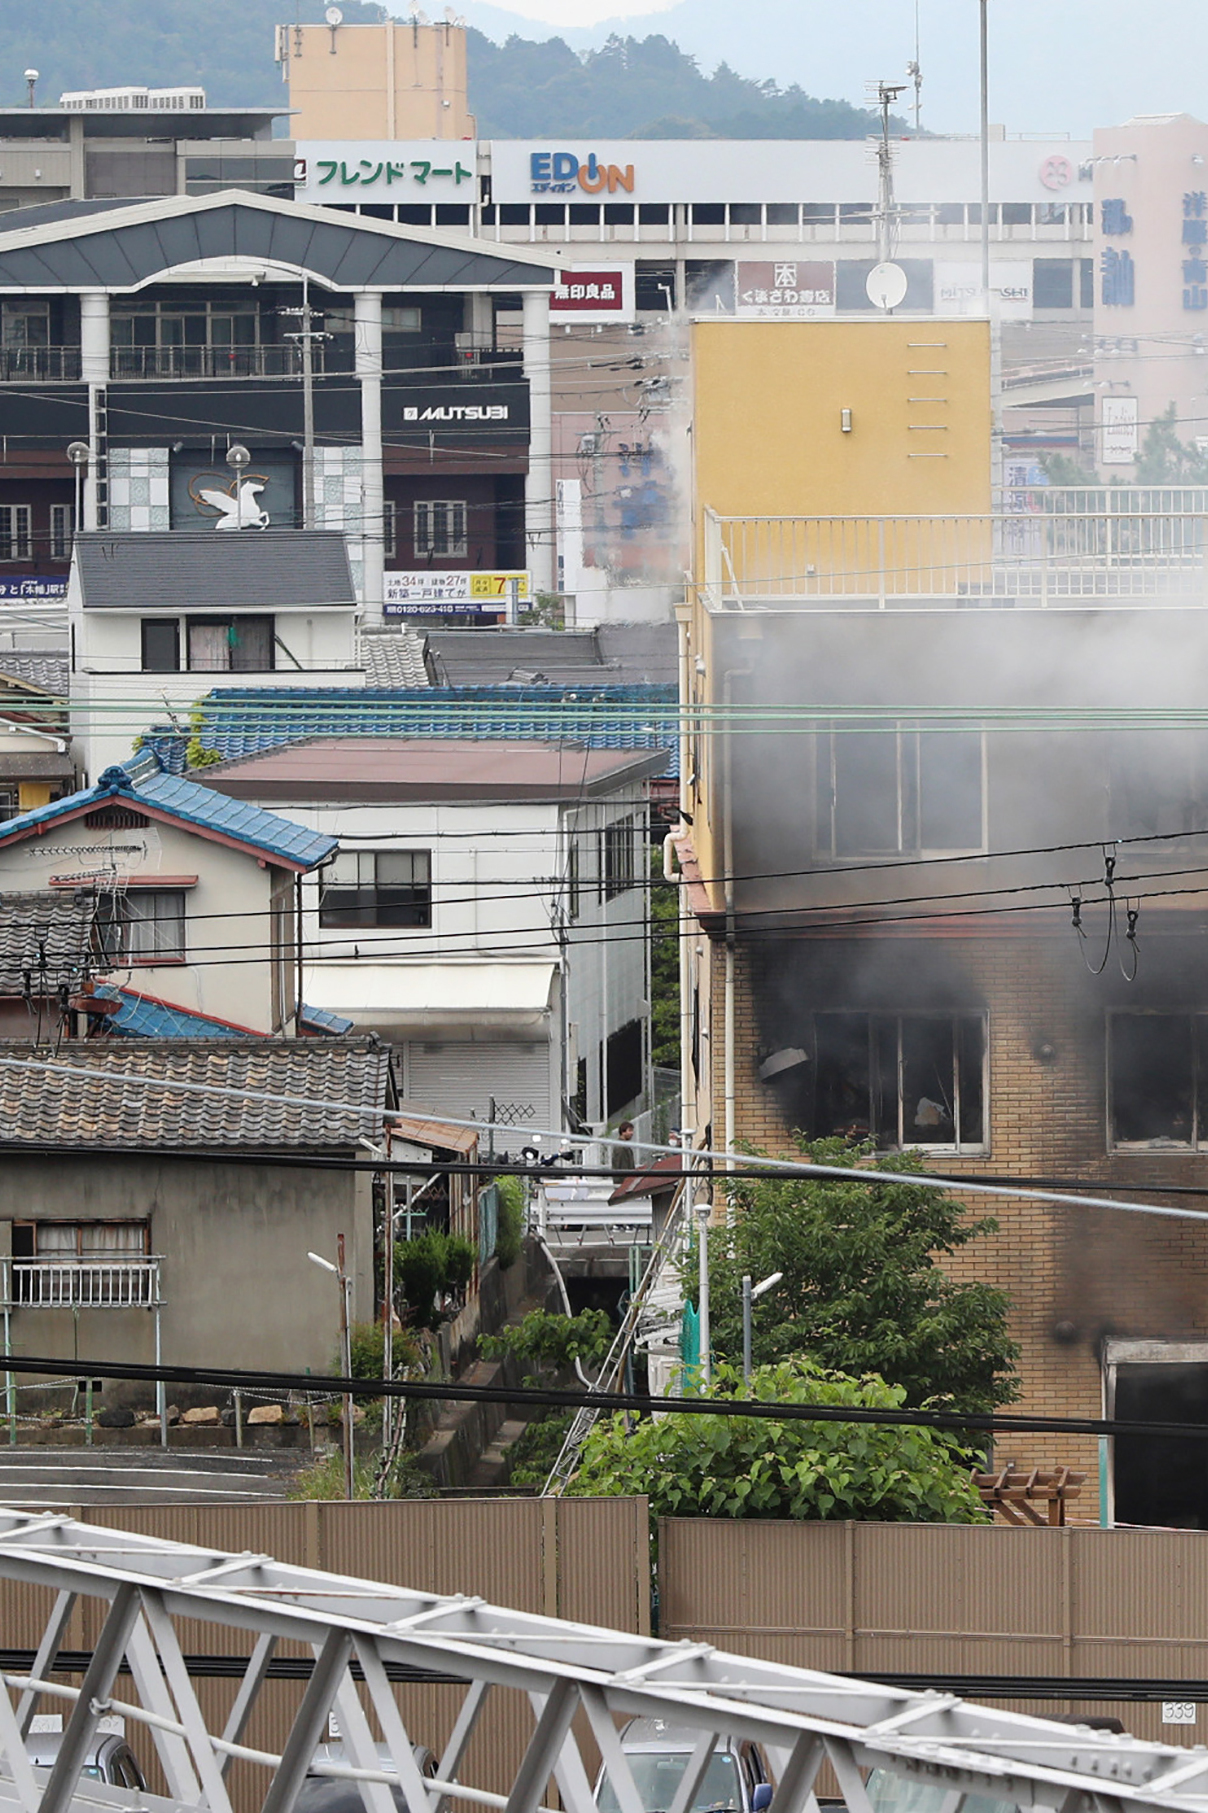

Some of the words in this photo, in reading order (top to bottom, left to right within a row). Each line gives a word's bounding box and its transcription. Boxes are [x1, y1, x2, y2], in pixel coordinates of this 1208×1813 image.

[317, 160, 472, 185] フレンドマート
[530, 152, 634, 194] EDION
[555, 282, 615, 300] 無印良品
[419, 405, 509, 420] MUTSUBI
